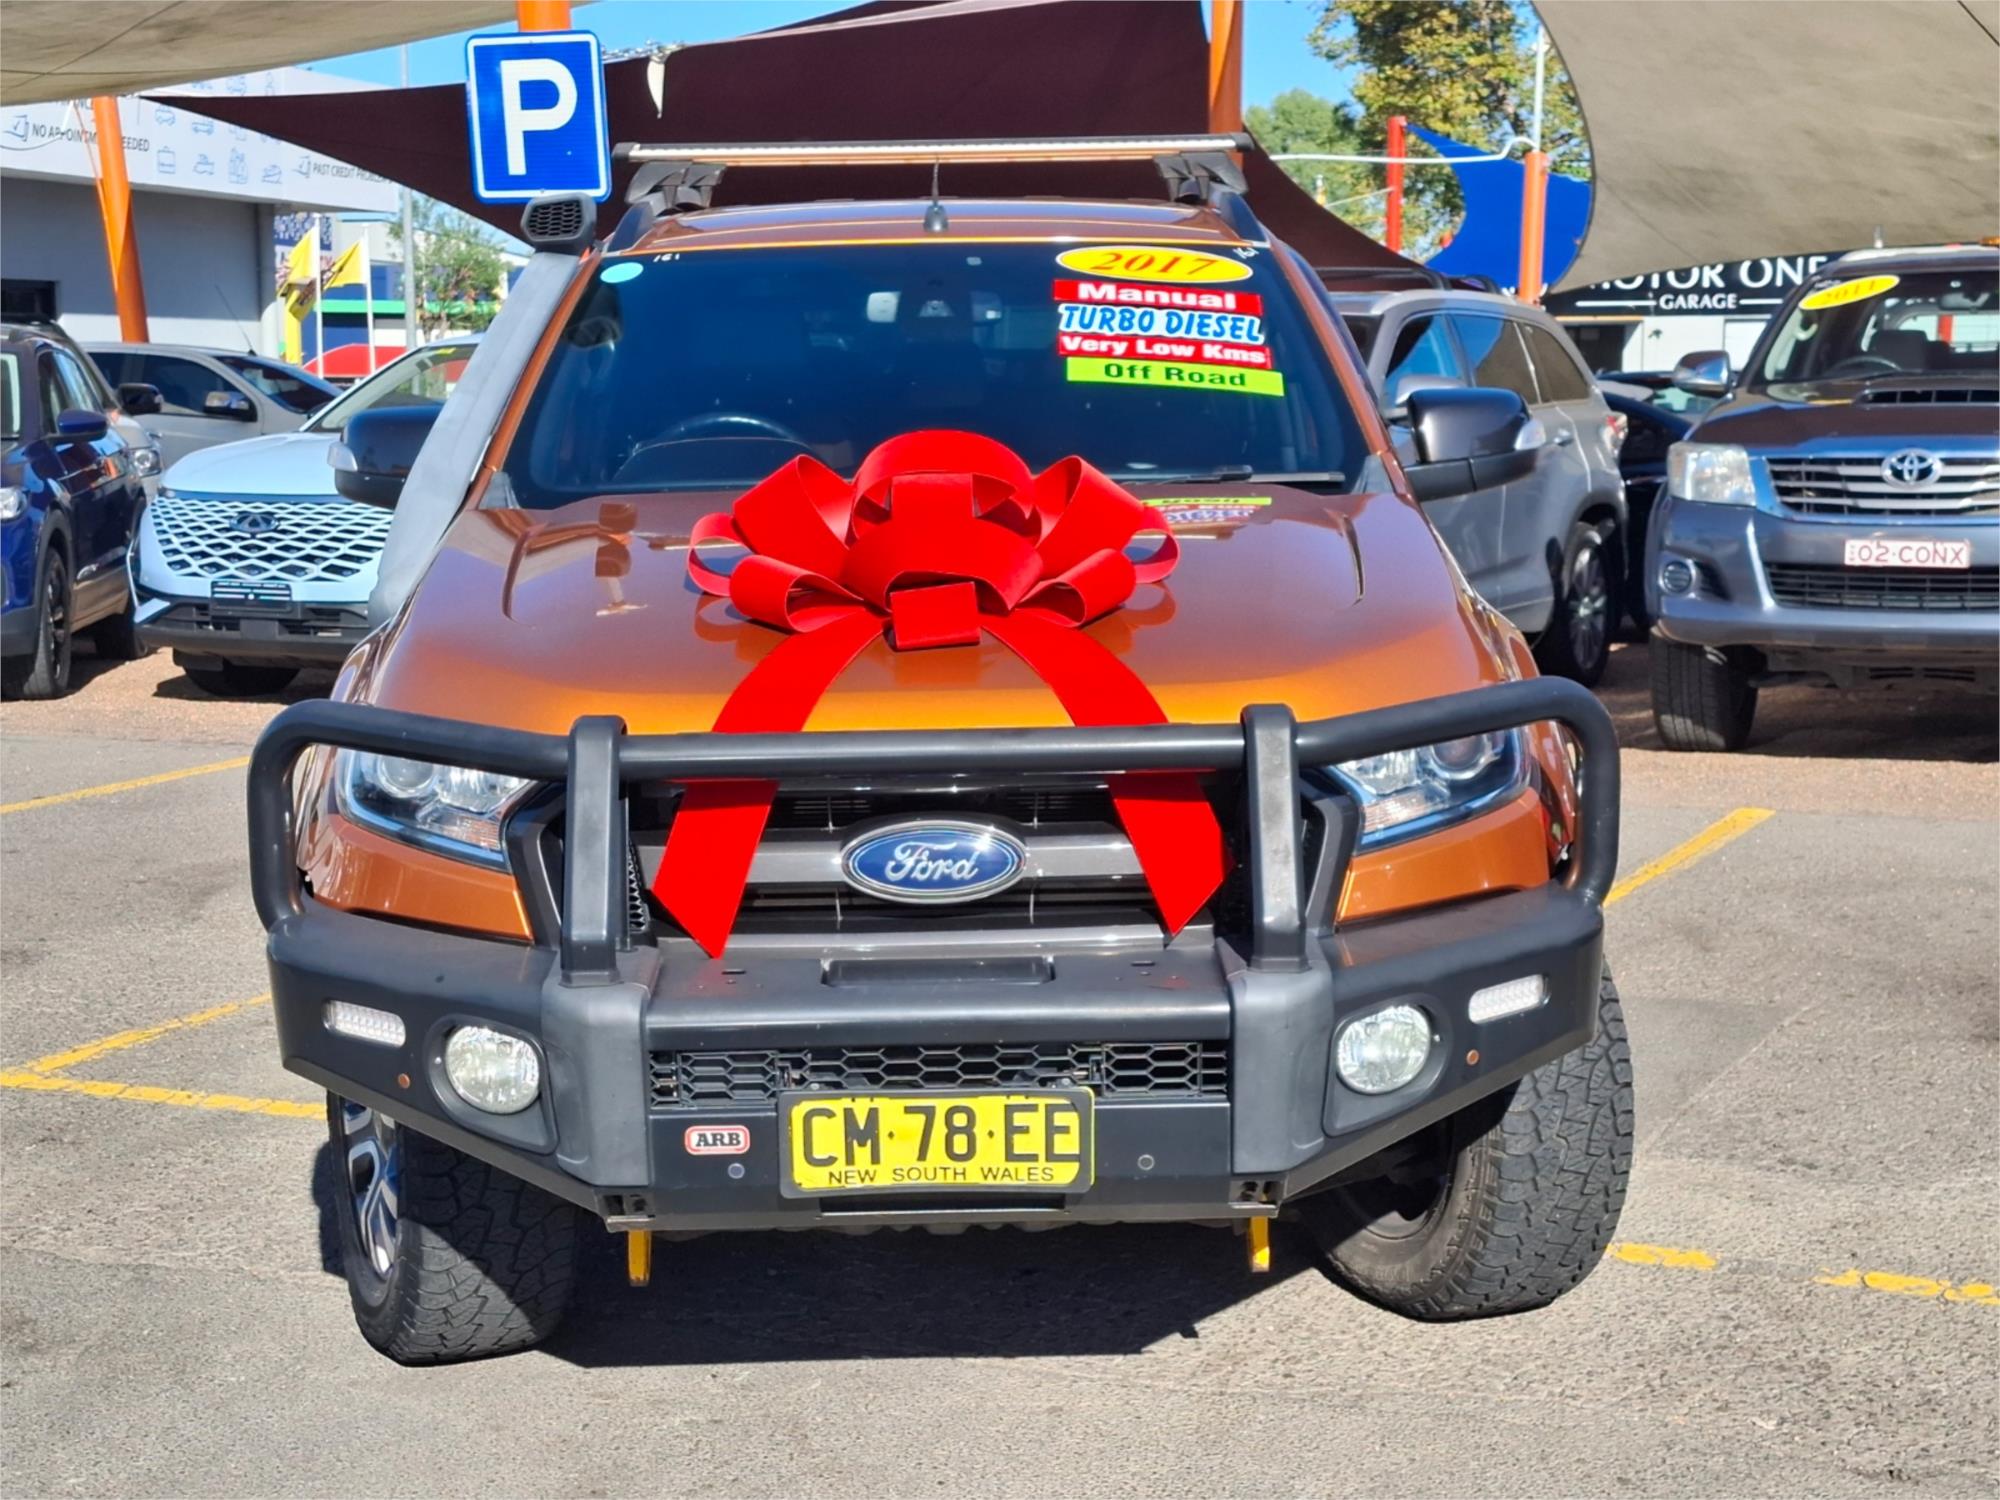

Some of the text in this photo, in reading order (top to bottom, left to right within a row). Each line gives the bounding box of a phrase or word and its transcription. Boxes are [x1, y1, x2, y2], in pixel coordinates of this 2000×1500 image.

[500, 58, 578, 176] P
[32, 123, 150, 152] NO APPOINTM EEDED
[1089, 251, 1220, 275] 2017
[1590, 263, 1726, 290] TOR
[1077, 282, 1237, 310] Manual
[1658, 293, 1738, 310] GARAGE
[1063, 305, 1264, 343] TURBO DIESEL
[1060, 335, 1267, 364] Very Low Kms
[1104, 363, 1247, 387] Off Road
[884, 841, 981, 882] Ford
[695, 1132, 741, 1147] ARB
[828, 1166, 1054, 1185] NEW SOUTH WALES
